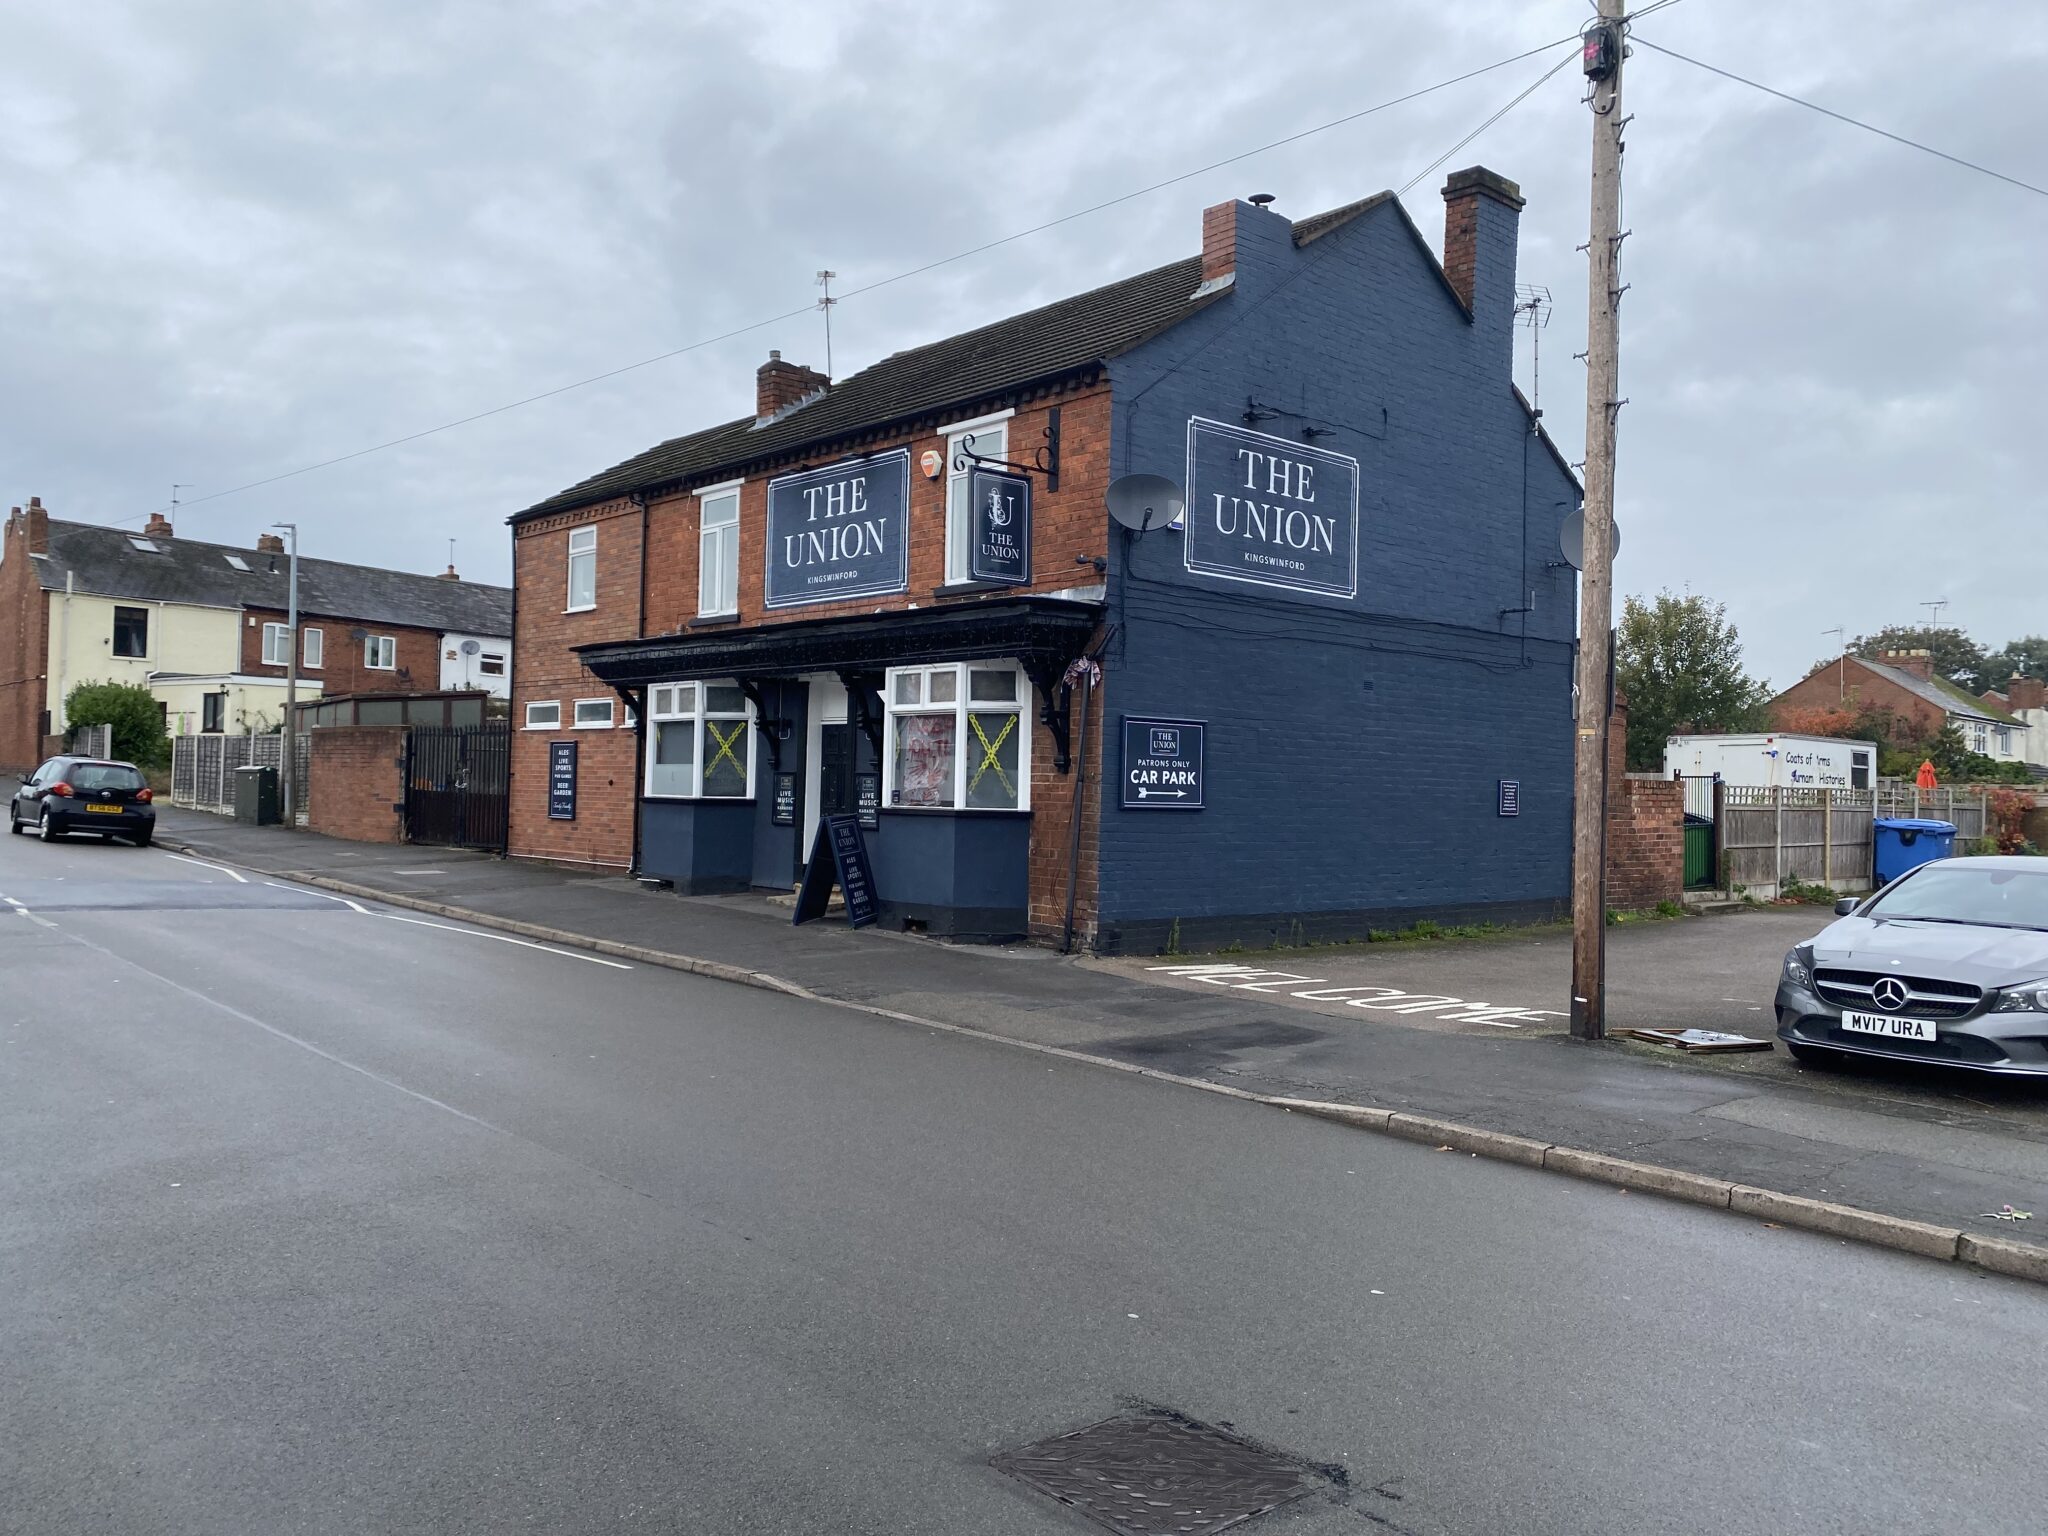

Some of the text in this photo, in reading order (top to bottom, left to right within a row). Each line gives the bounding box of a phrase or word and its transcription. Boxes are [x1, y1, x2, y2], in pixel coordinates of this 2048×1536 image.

[1238, 448, 1315, 503] THE
[803, 477, 867, 522] THE
[1212, 493, 1336, 556] UNION
[784, 518, 887, 568] UNION
[988, 532, 1013, 546] THE
[981, 544, 1020, 560] UNION
[1244, 552, 1305, 571] KINGSWINFORD
[807, 570, 858, 585] KINGSWINFORD
[1153, 740, 1177, 749] UNION
[1157, 732, 1173, 741] THE
[1137, 759, 1190, 768] PATRONS ONLY
[1785, 751, 1804, 765] Coats
[1805, 753, 1813, 766] of
[1130, 769, 1197, 785] CAR PARK
[1818, 772, 1845, 786] Histories
[838, 837, 856, 847] UNION
[1144, 963, 1572, 1028] WELCOME
[1852, 1014, 1924, 1037] MV17 URA
